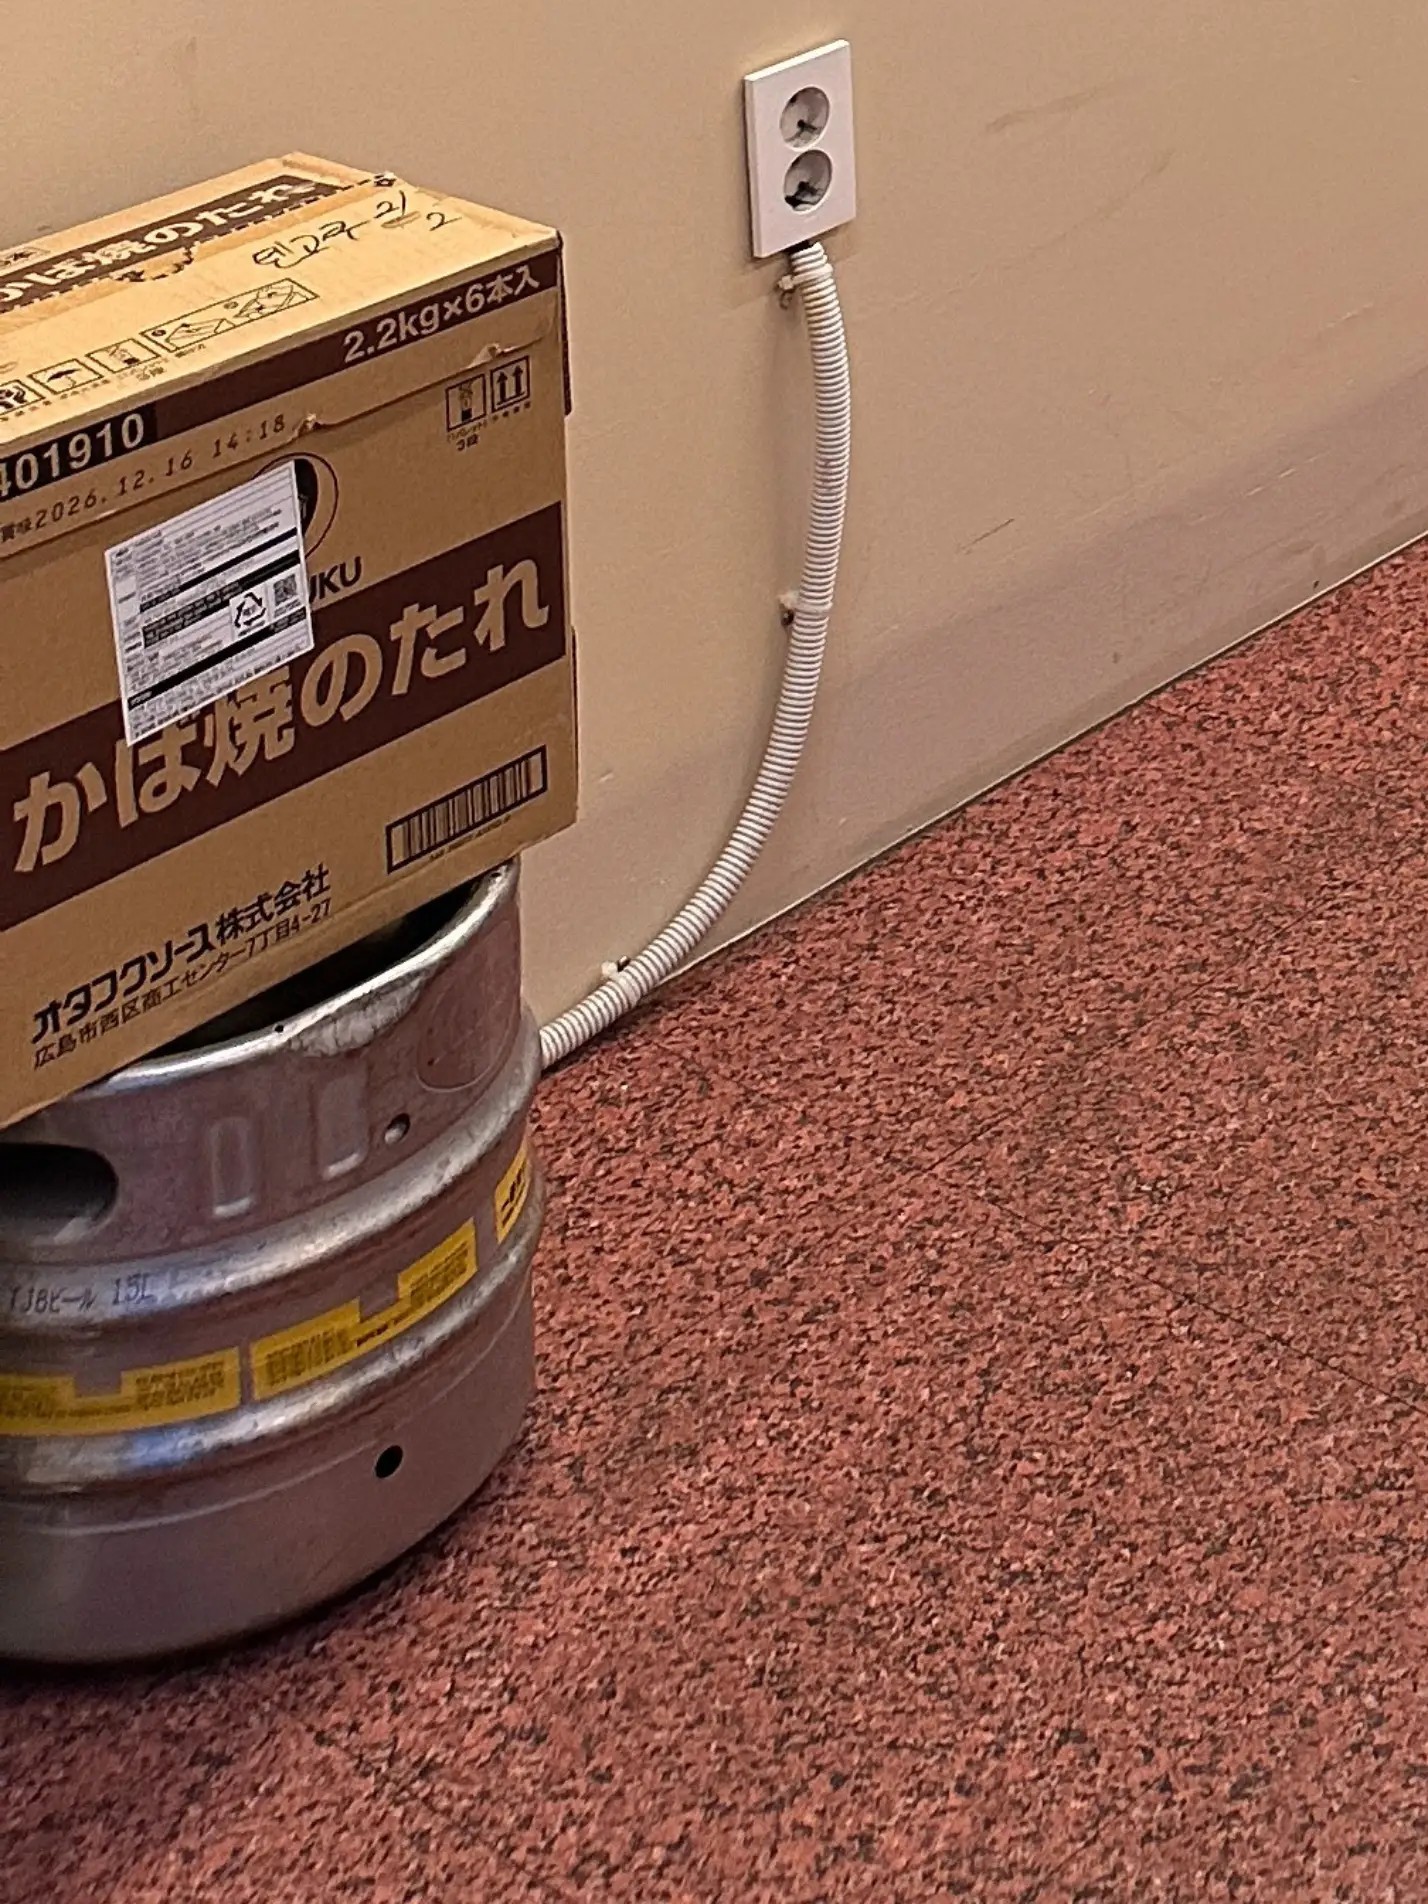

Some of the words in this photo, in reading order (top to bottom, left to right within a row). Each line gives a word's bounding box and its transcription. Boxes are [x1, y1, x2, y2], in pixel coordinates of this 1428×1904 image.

[31, 862, 331, 1045] オタフクソース株式会社
